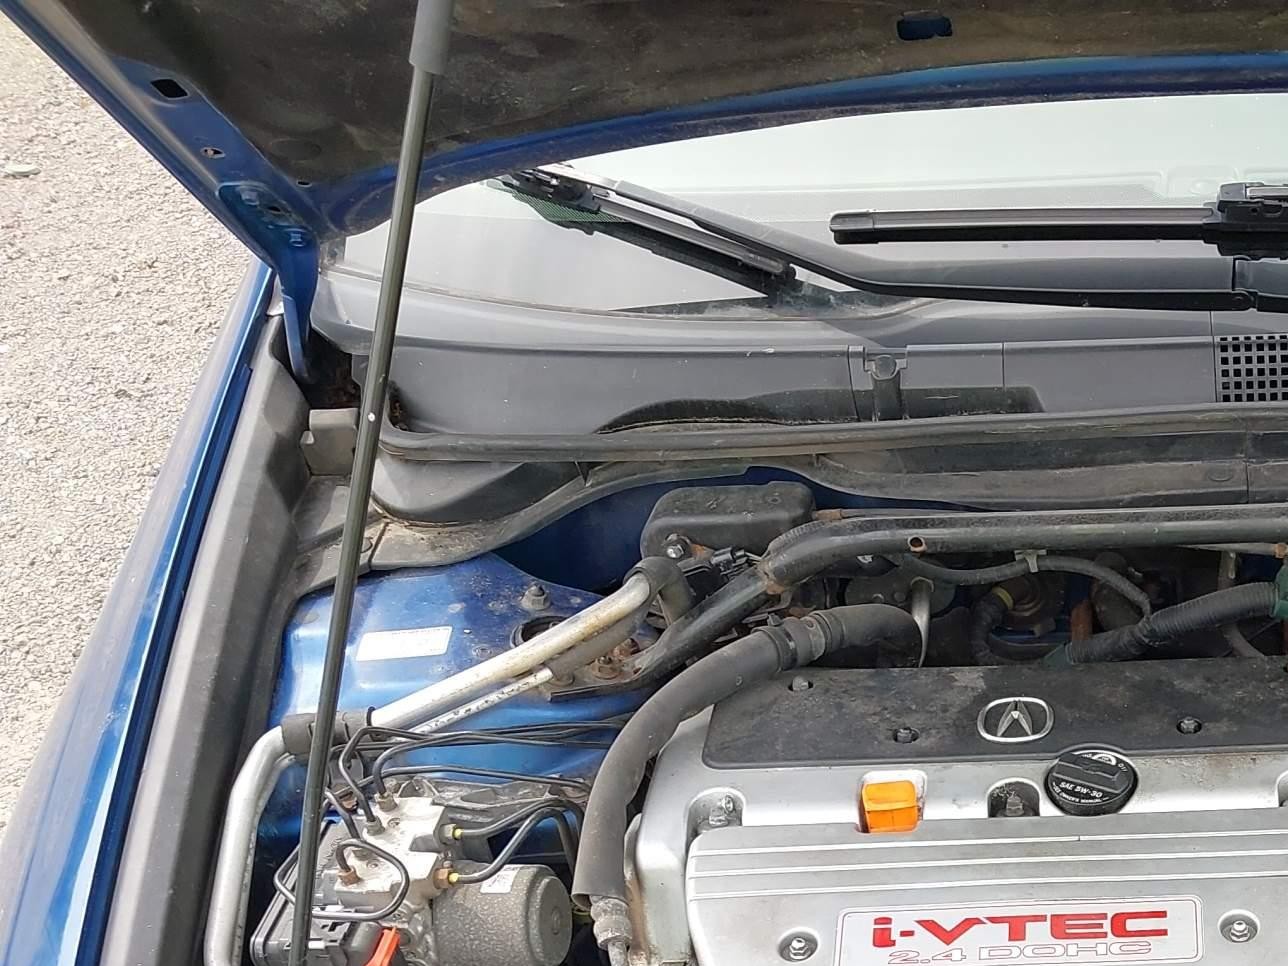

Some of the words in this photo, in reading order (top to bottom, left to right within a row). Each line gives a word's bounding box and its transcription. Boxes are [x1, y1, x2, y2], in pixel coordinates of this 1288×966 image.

[1059, 781, 1074, 791] SAE
[1075, 785, 1104, 798] 5W-30
[872, 910, 1168, 948] i-VTEC
[888, 948, 967, 965] 2.4
[978, 940, 1152, 961] DOHC
